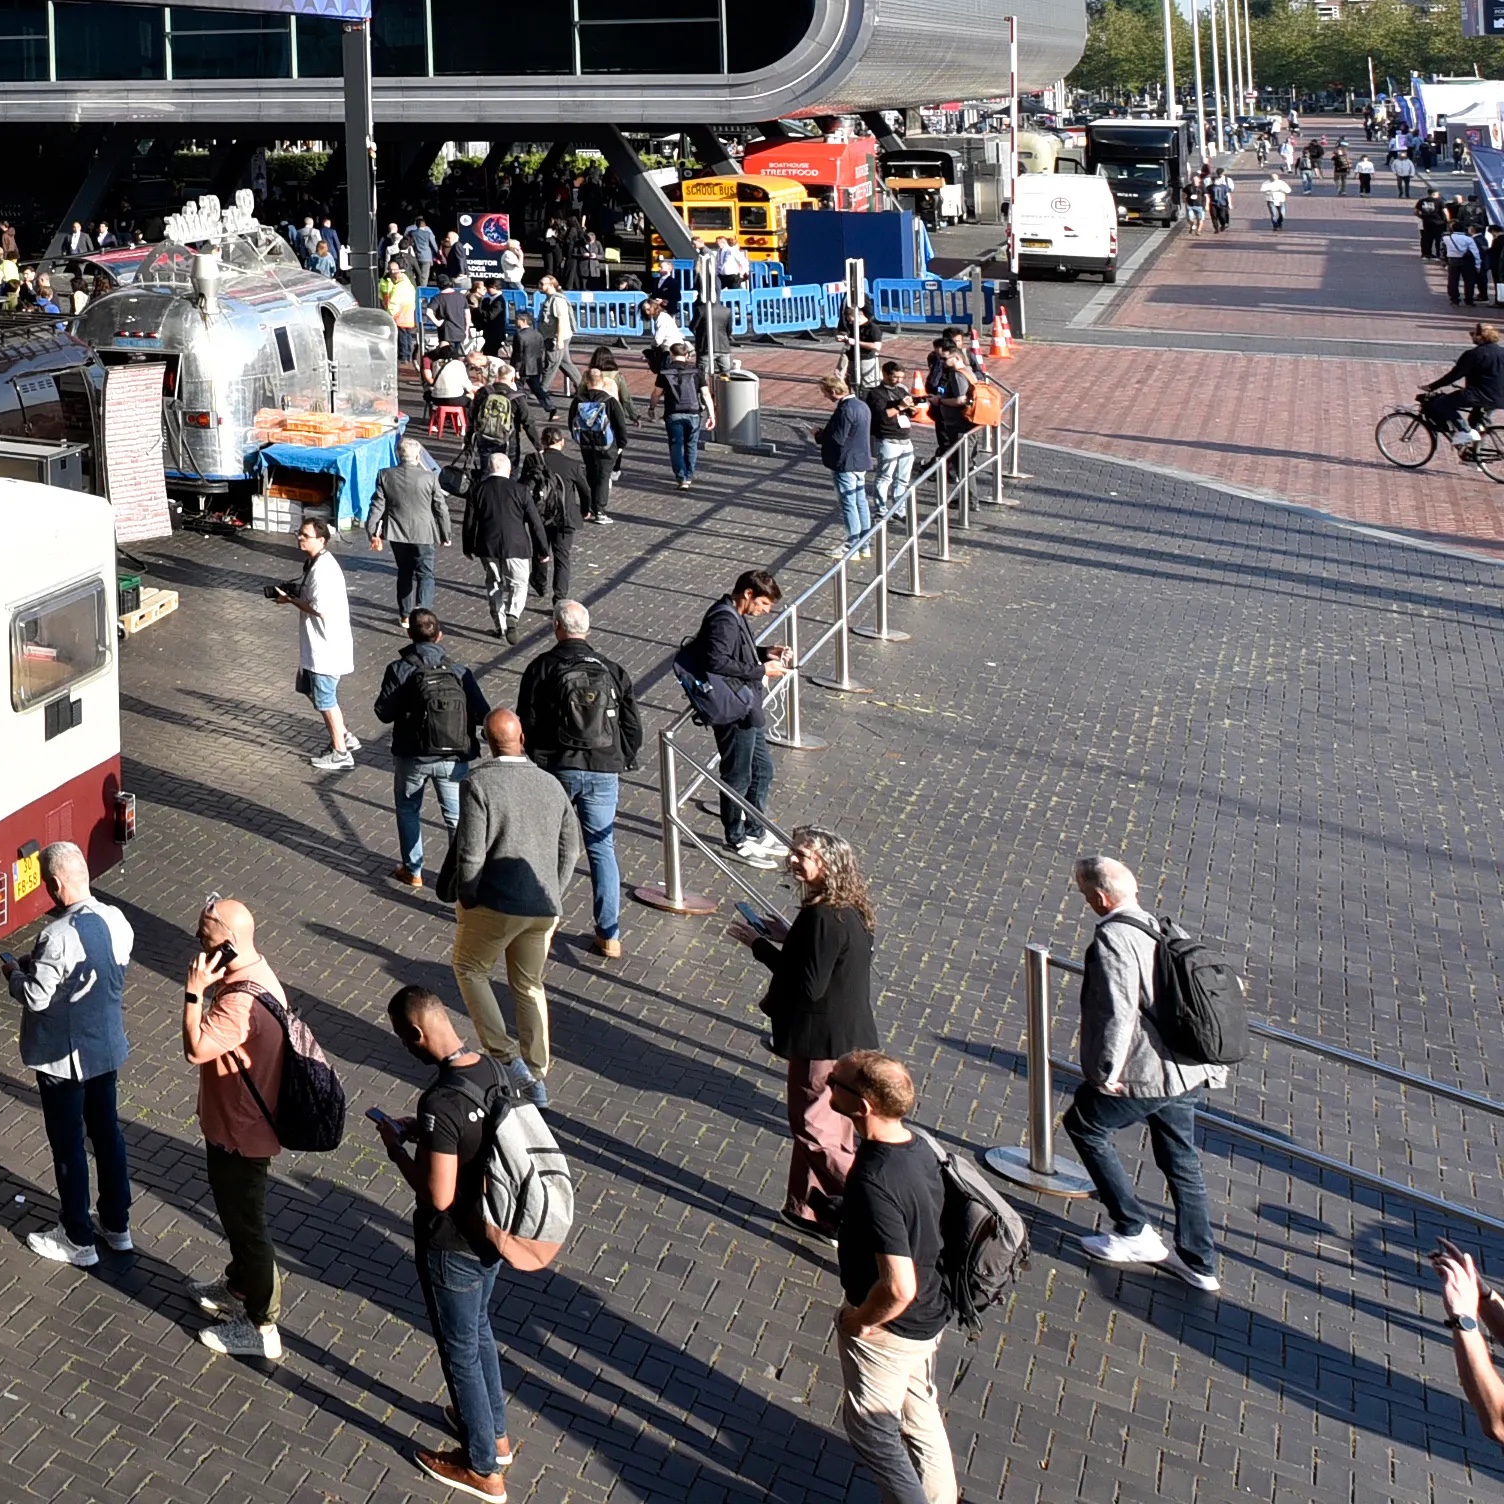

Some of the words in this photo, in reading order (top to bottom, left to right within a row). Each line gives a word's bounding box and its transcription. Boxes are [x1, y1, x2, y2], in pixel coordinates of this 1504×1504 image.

[760, 169, 819, 177] STREETFOOD
[686, 183, 717, 195] SCHOOL
[719, 185, 735, 195] BUS
